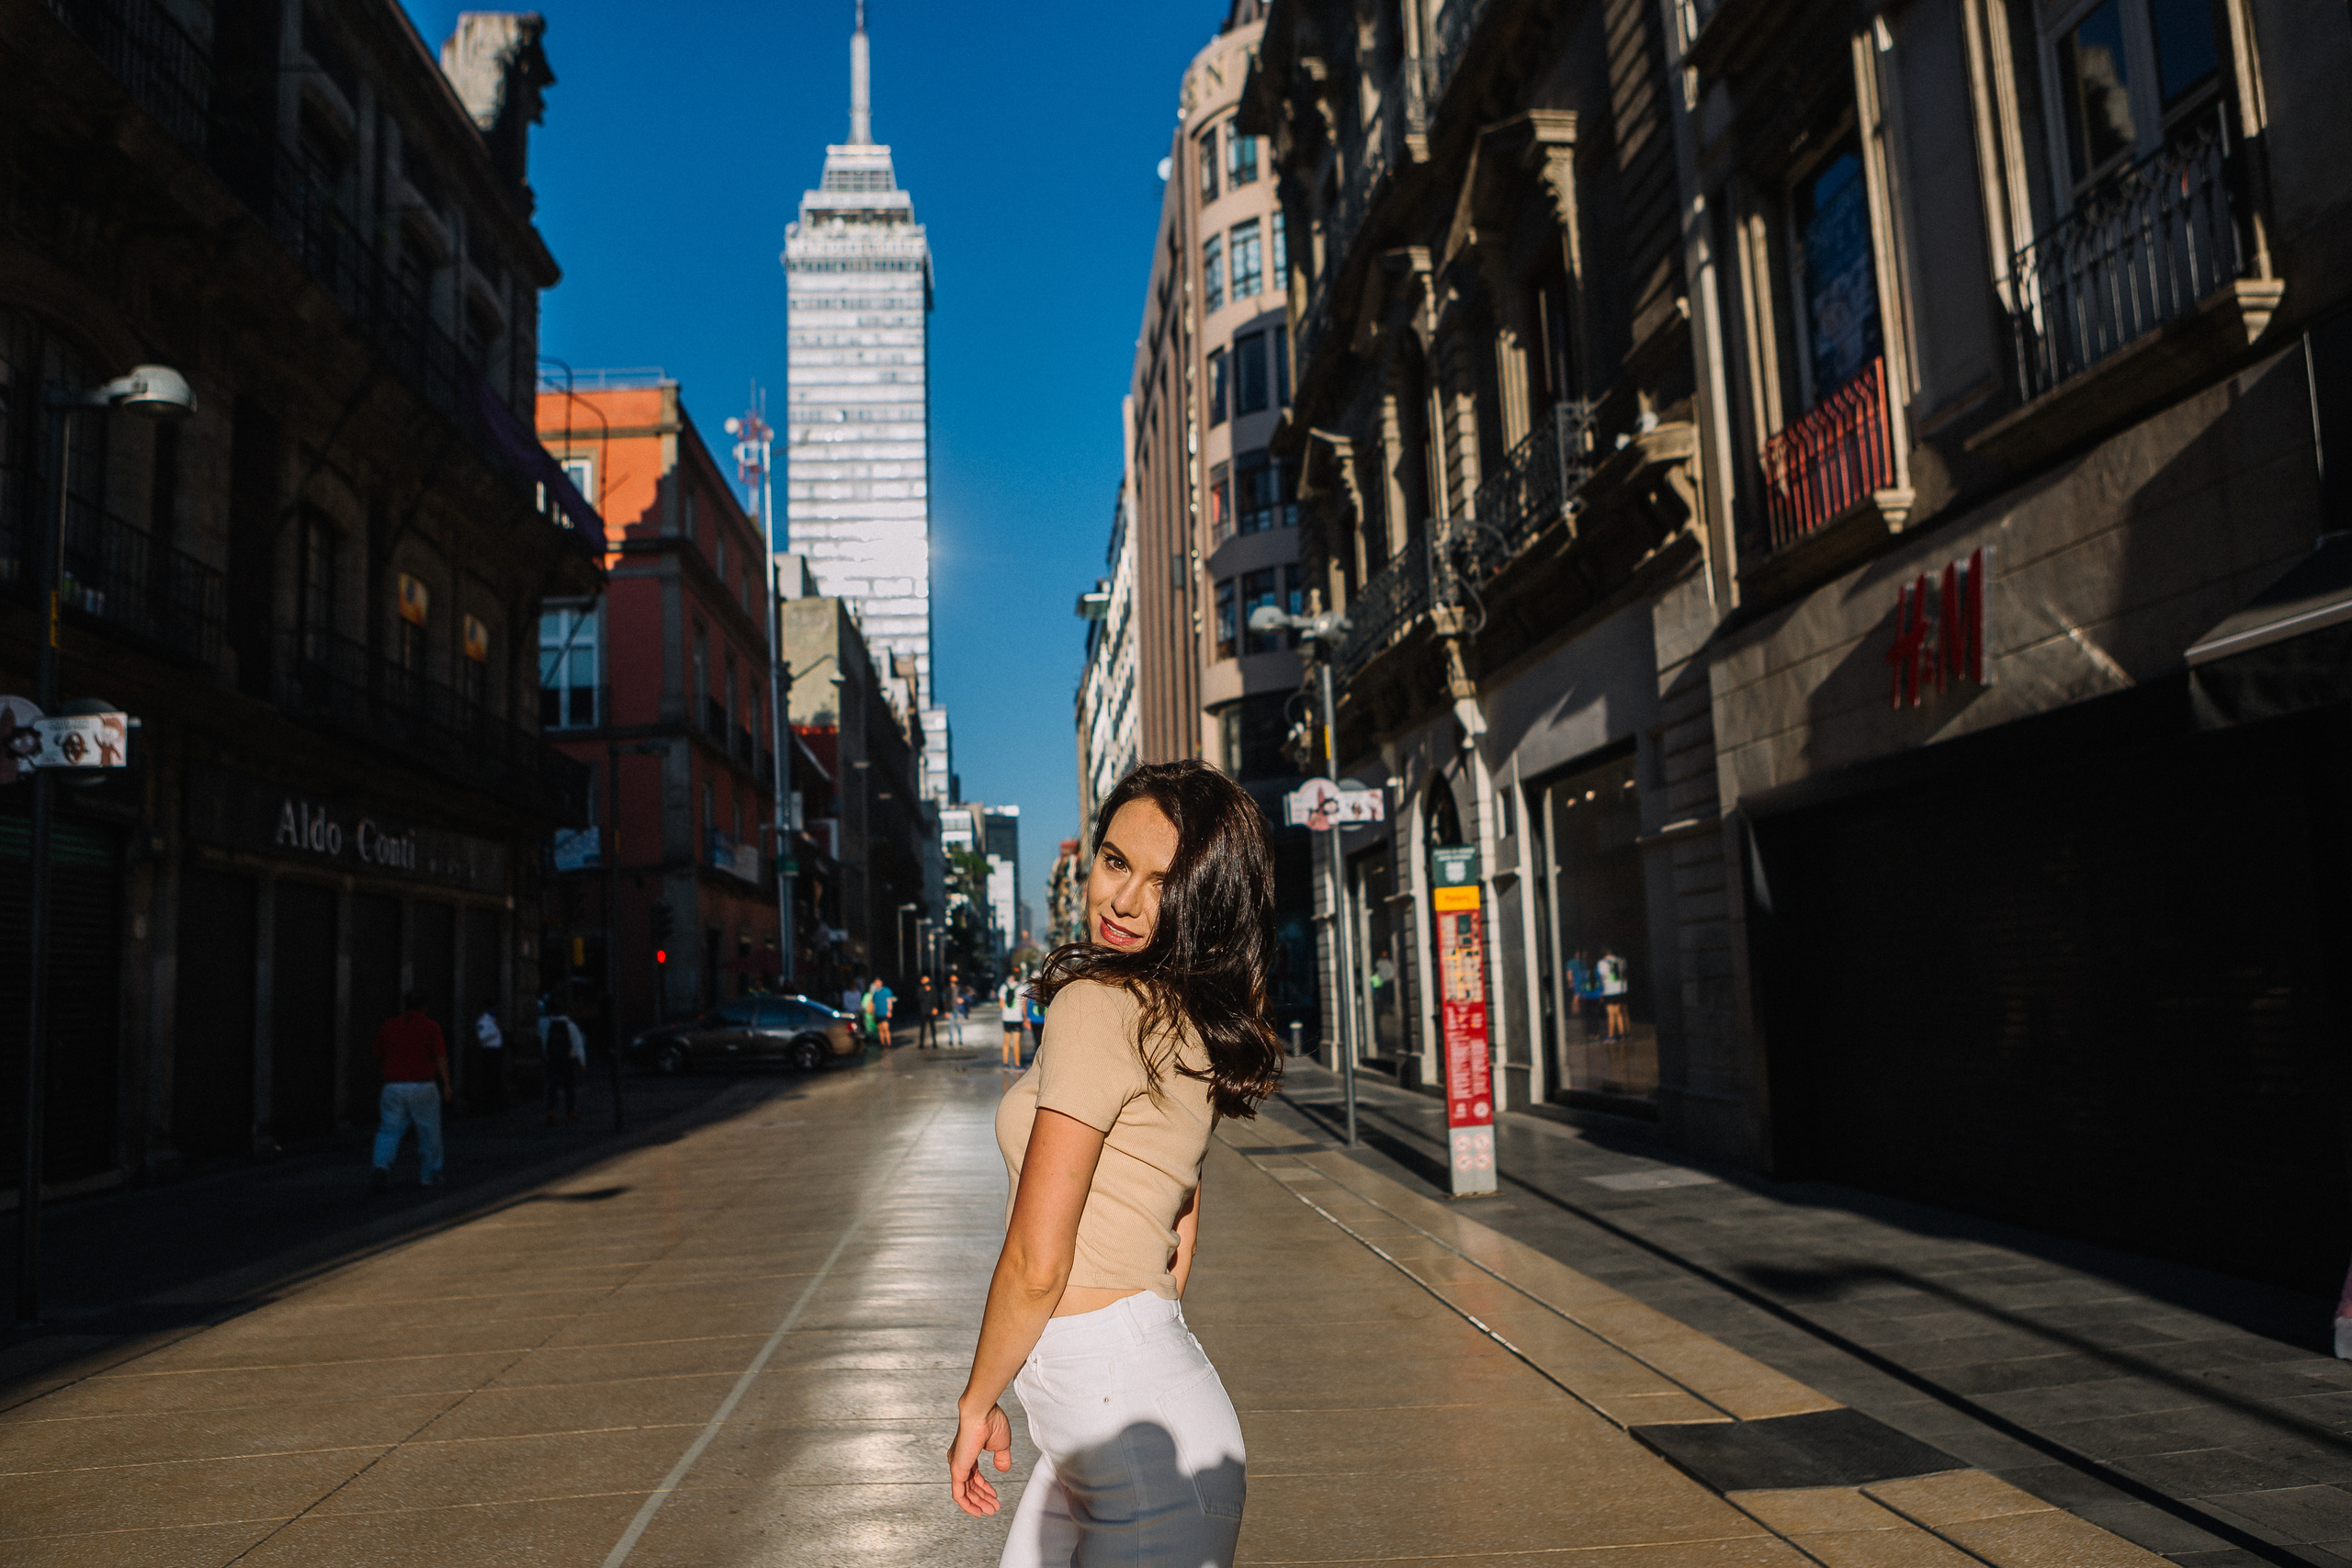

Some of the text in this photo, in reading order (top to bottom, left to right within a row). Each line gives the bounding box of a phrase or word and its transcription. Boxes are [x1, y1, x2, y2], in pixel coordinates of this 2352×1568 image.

[1886, 547, 1992, 710] H&M
[275, 799, 343, 856] Aldo
[356, 818, 416, 871] Conti
